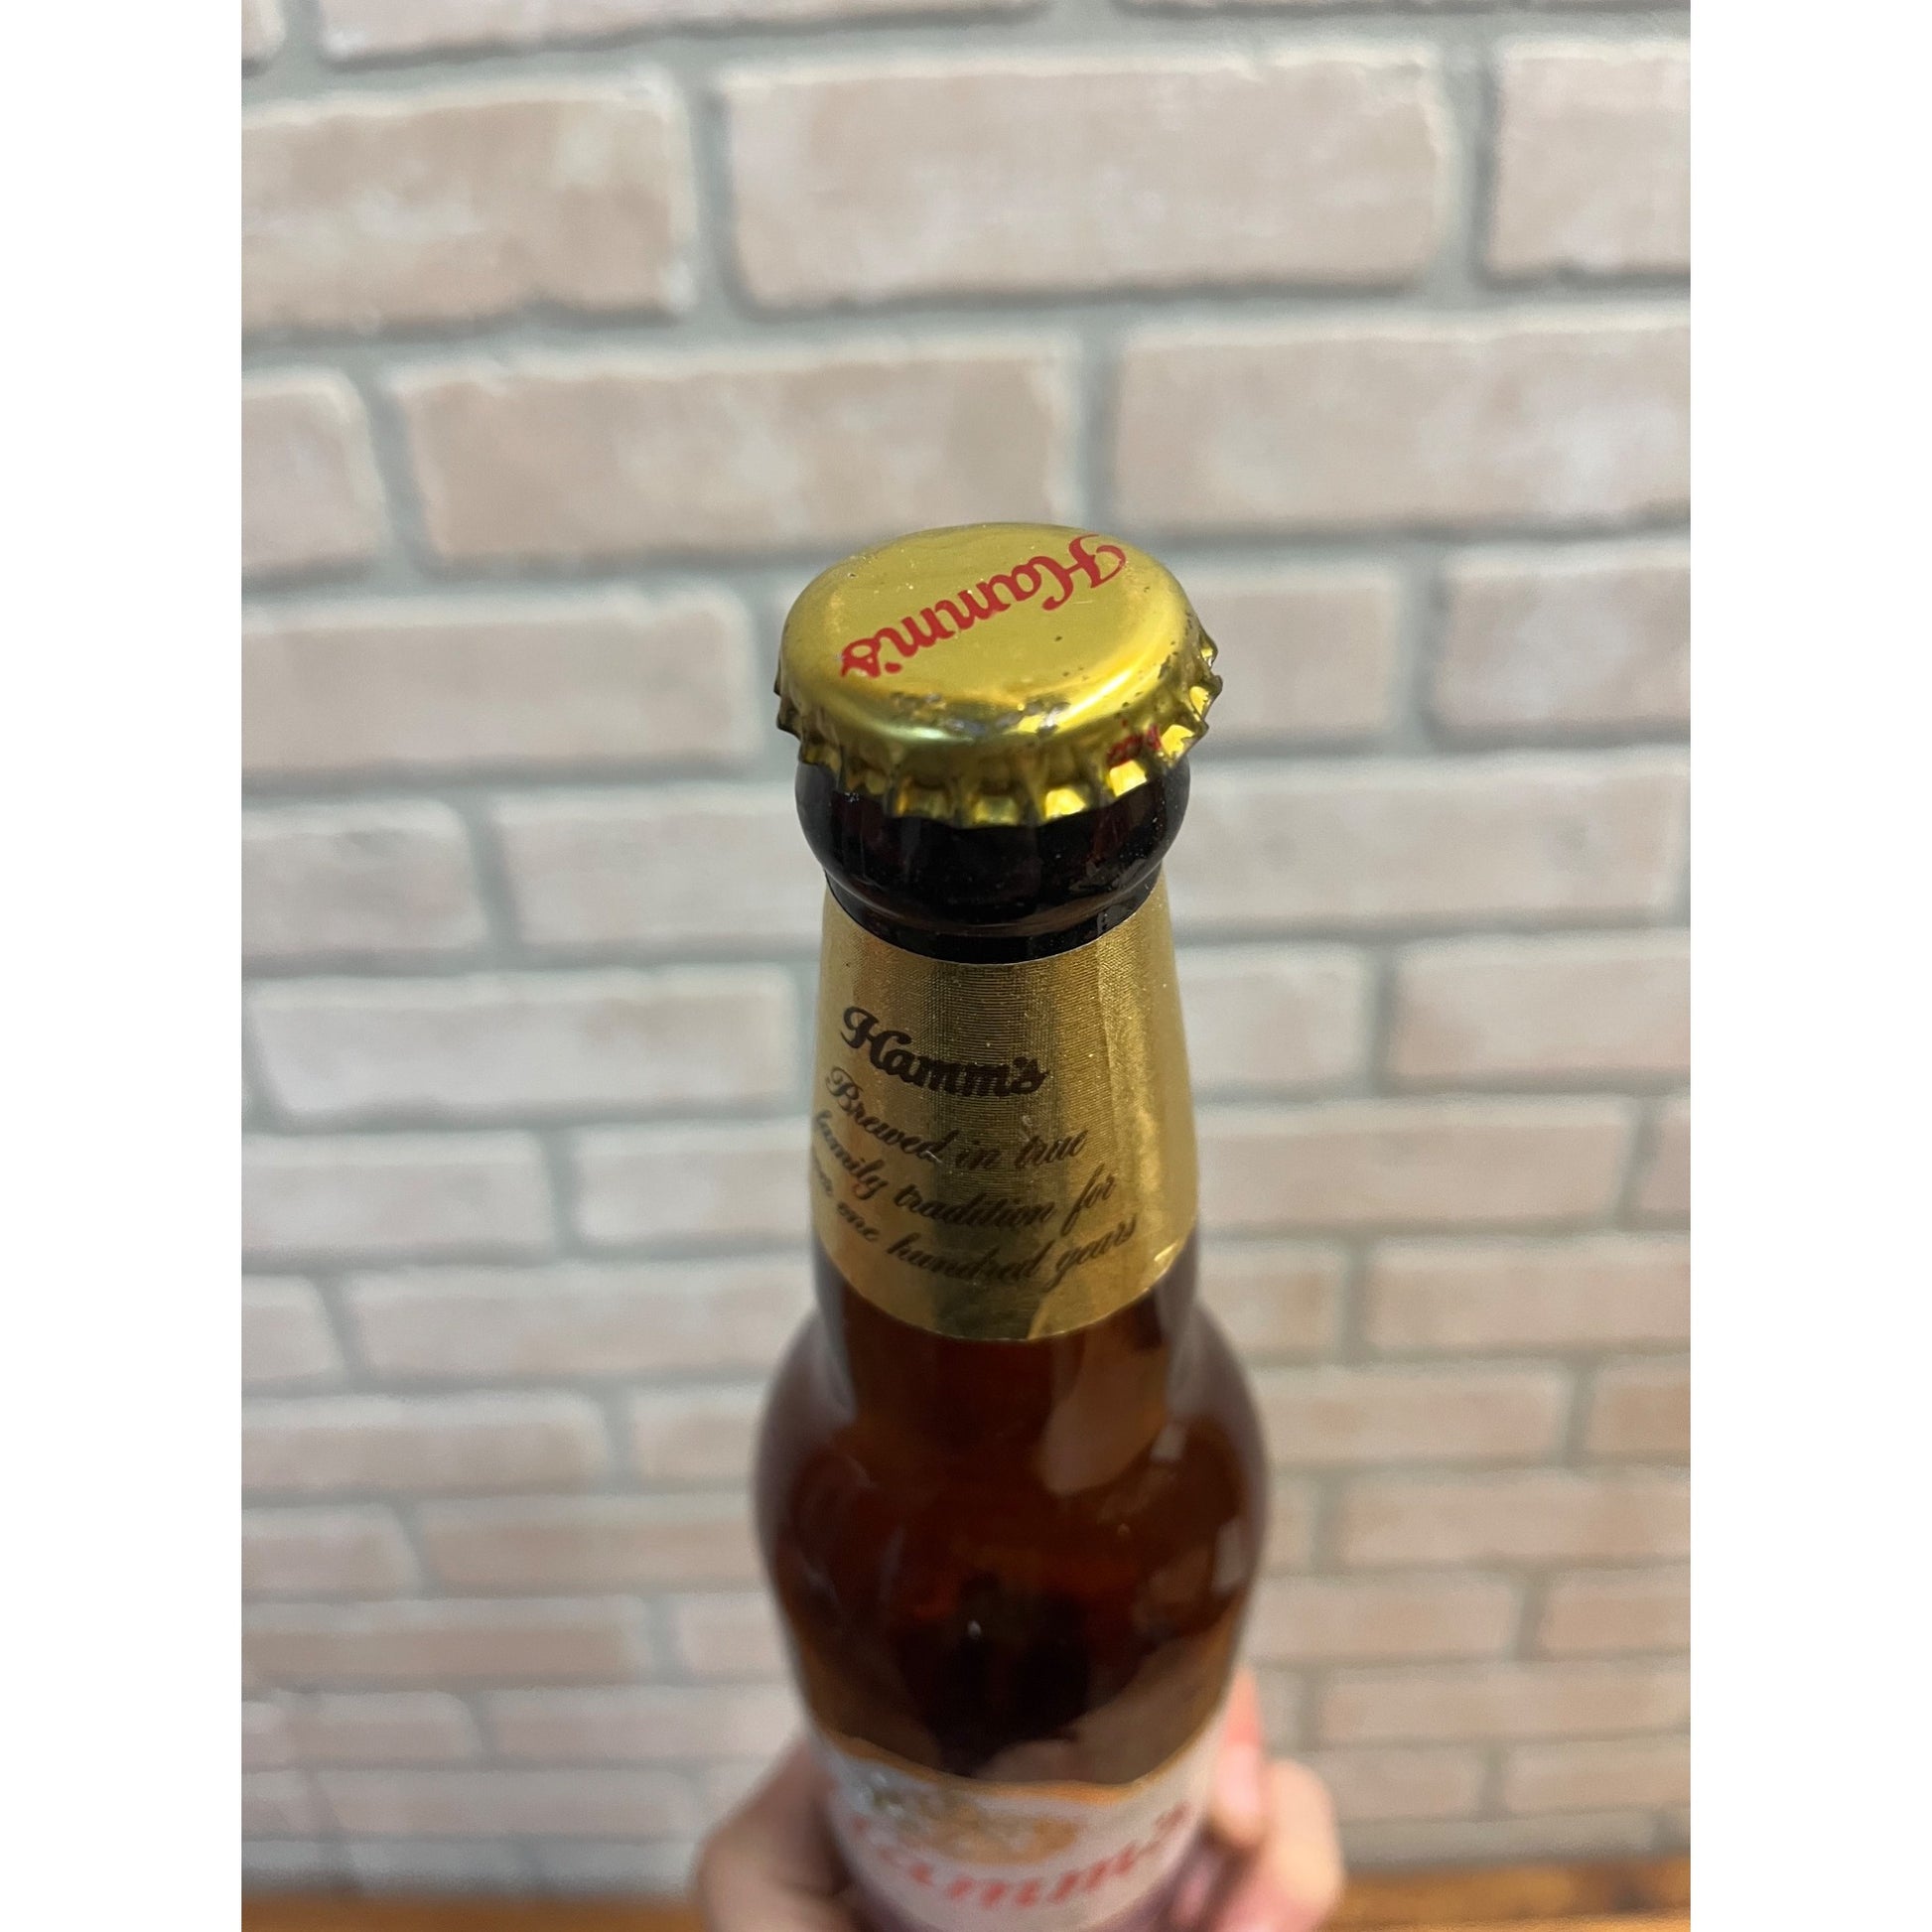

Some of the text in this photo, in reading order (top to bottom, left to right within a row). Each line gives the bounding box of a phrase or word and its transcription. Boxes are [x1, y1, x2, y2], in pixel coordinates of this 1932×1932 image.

[840, 533, 1127, 679] Hamm's
[840, 1006, 1050, 1097] Hamm's
[825, 1065, 1089, 1171] Brewed in true
[895, 1182, 1056, 1228] tradition
[1060, 1163, 1118, 1237] for
[888, 1232, 1055, 1283] hundred
[1040, 1212, 1137, 1294] years
